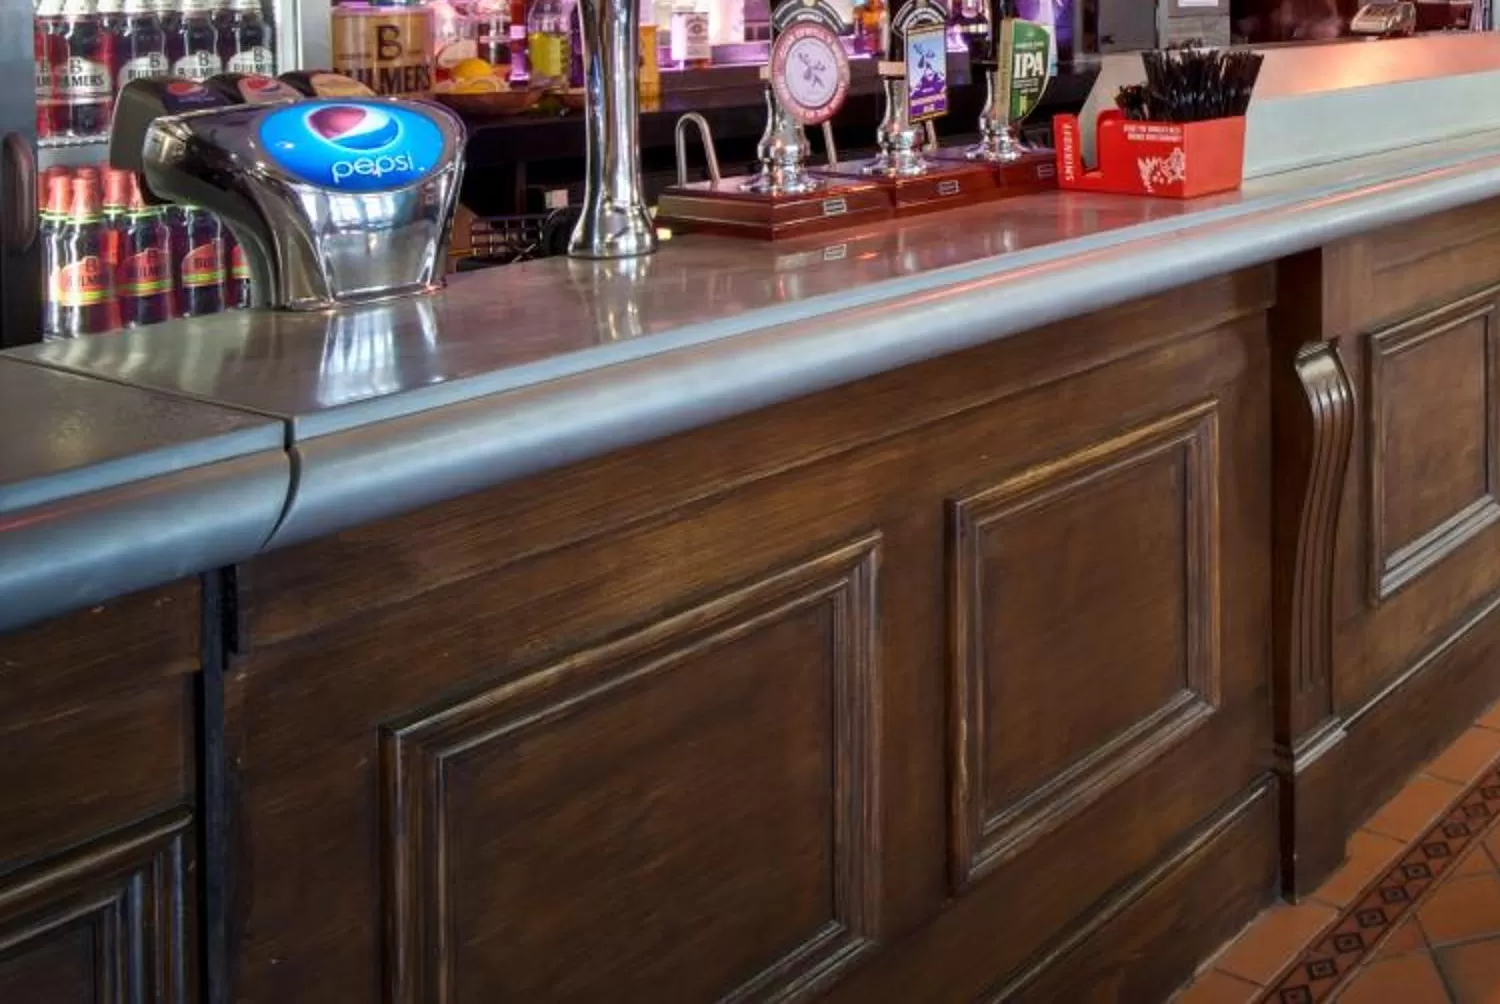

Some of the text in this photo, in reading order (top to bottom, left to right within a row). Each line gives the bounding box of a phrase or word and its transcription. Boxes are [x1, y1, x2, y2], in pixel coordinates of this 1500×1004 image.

[376, 24, 402, 61] B
[1013, 51, 1044, 79] IPA
[331, 150, 415, 183] pepsi
